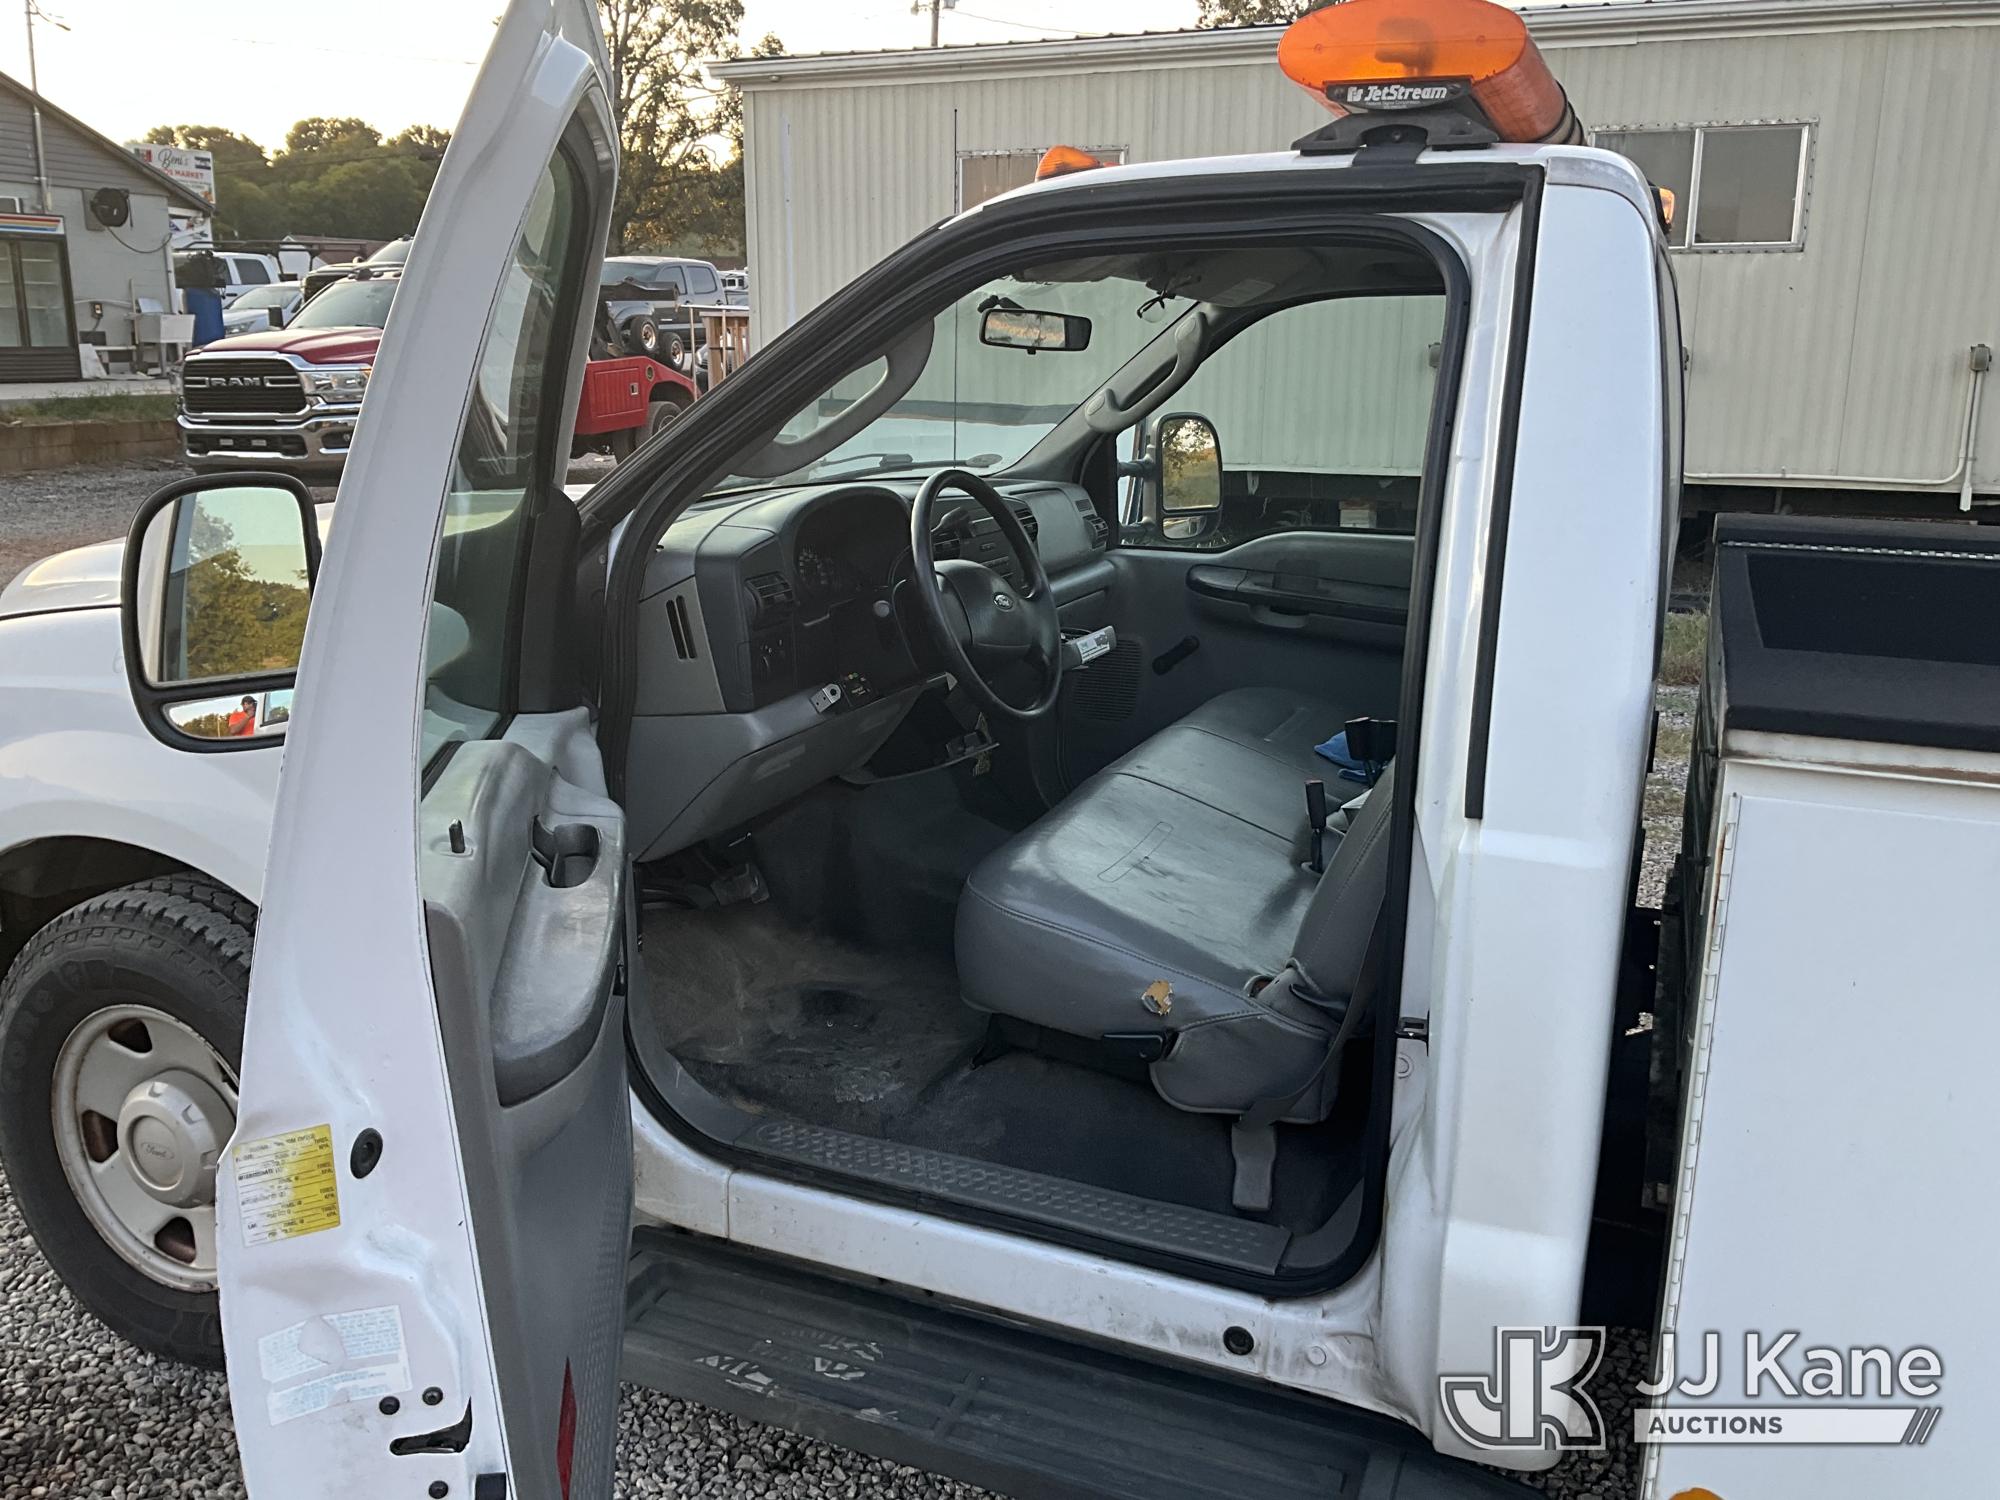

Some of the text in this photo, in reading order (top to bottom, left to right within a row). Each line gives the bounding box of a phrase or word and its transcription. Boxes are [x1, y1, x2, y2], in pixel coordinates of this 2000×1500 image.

[1364, 84, 1447, 102] JetStream
[175, 169, 204, 179] MARKET
[210, 376, 260, 387] RAM
